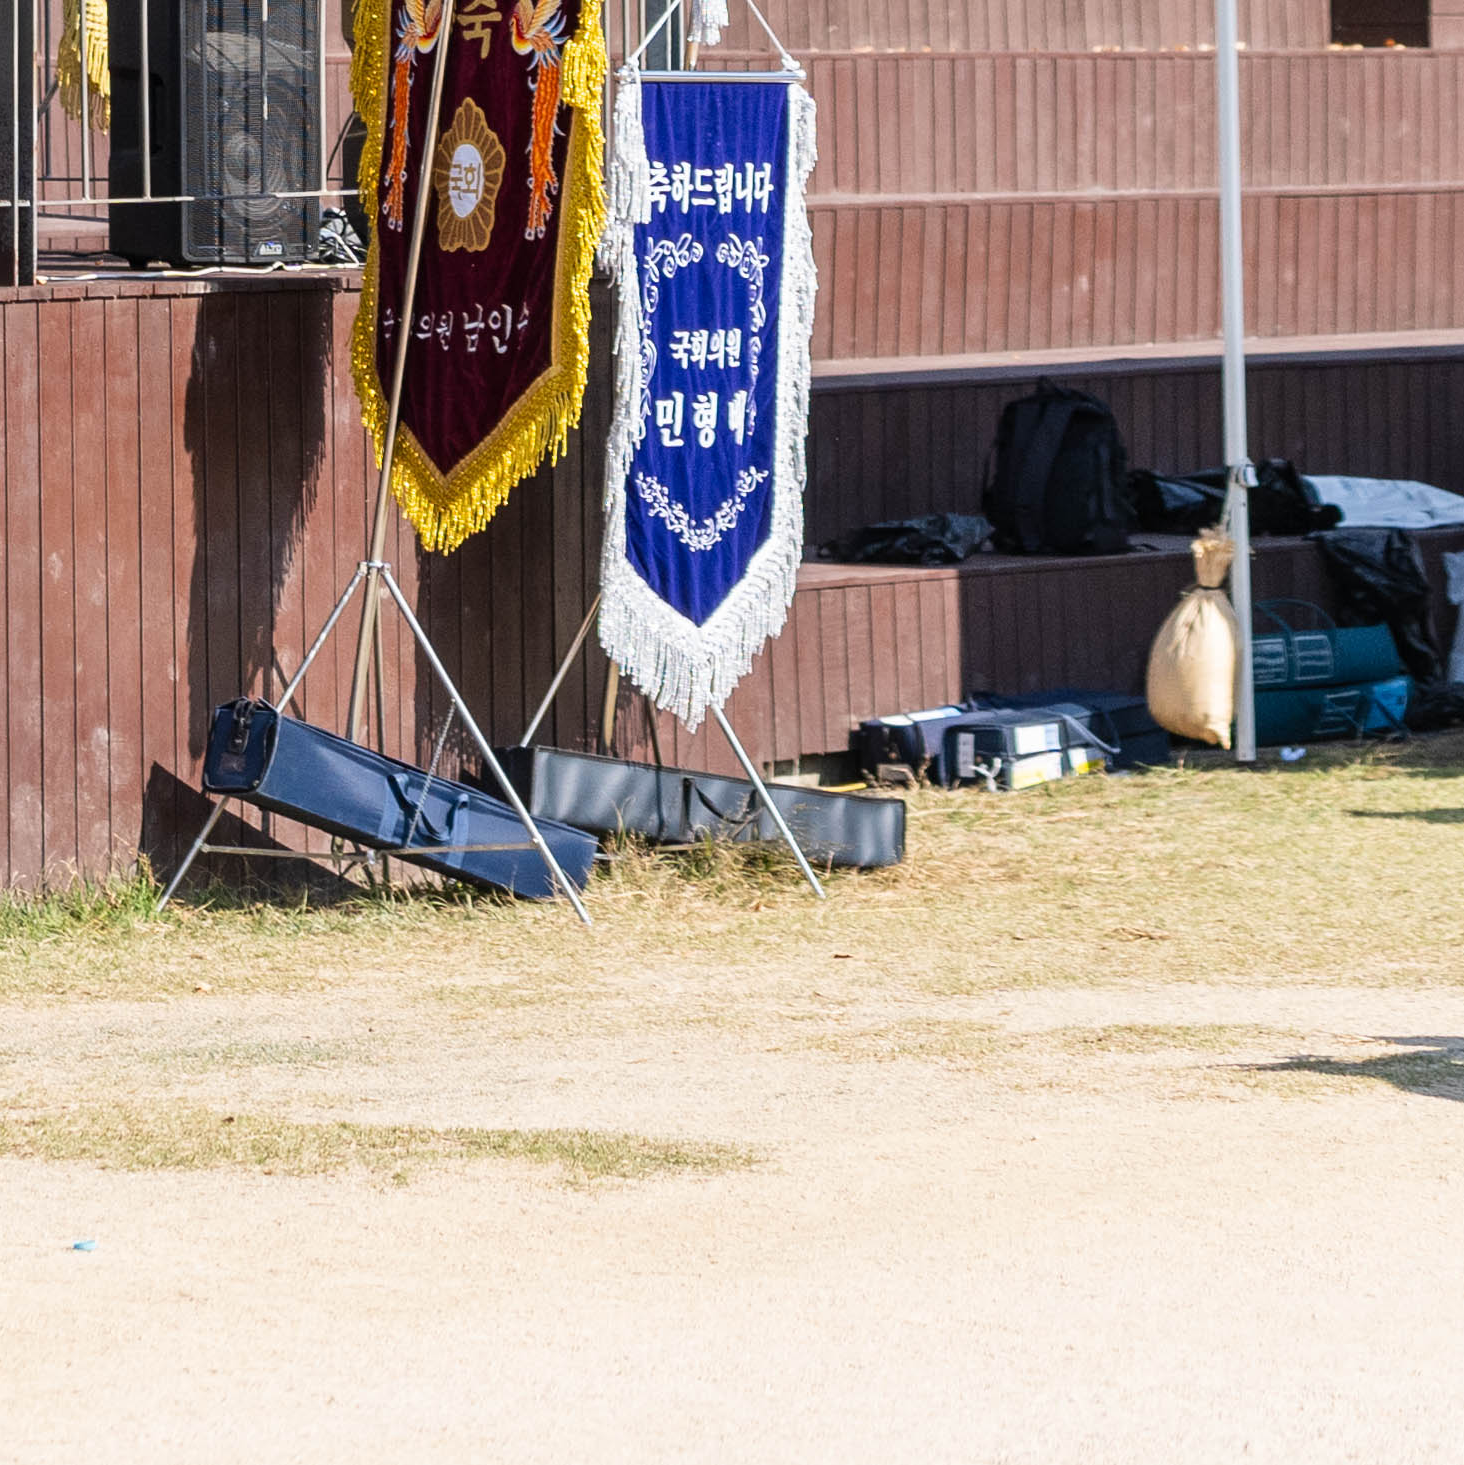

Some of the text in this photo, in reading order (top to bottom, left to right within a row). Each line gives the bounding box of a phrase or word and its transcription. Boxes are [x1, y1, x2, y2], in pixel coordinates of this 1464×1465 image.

[450, 162, 481, 201] 국회
[647, 161, 774, 215] 축하드립니다
[383, 307, 453, 351] 의원
[669, 328, 742, 370] 국회의원
